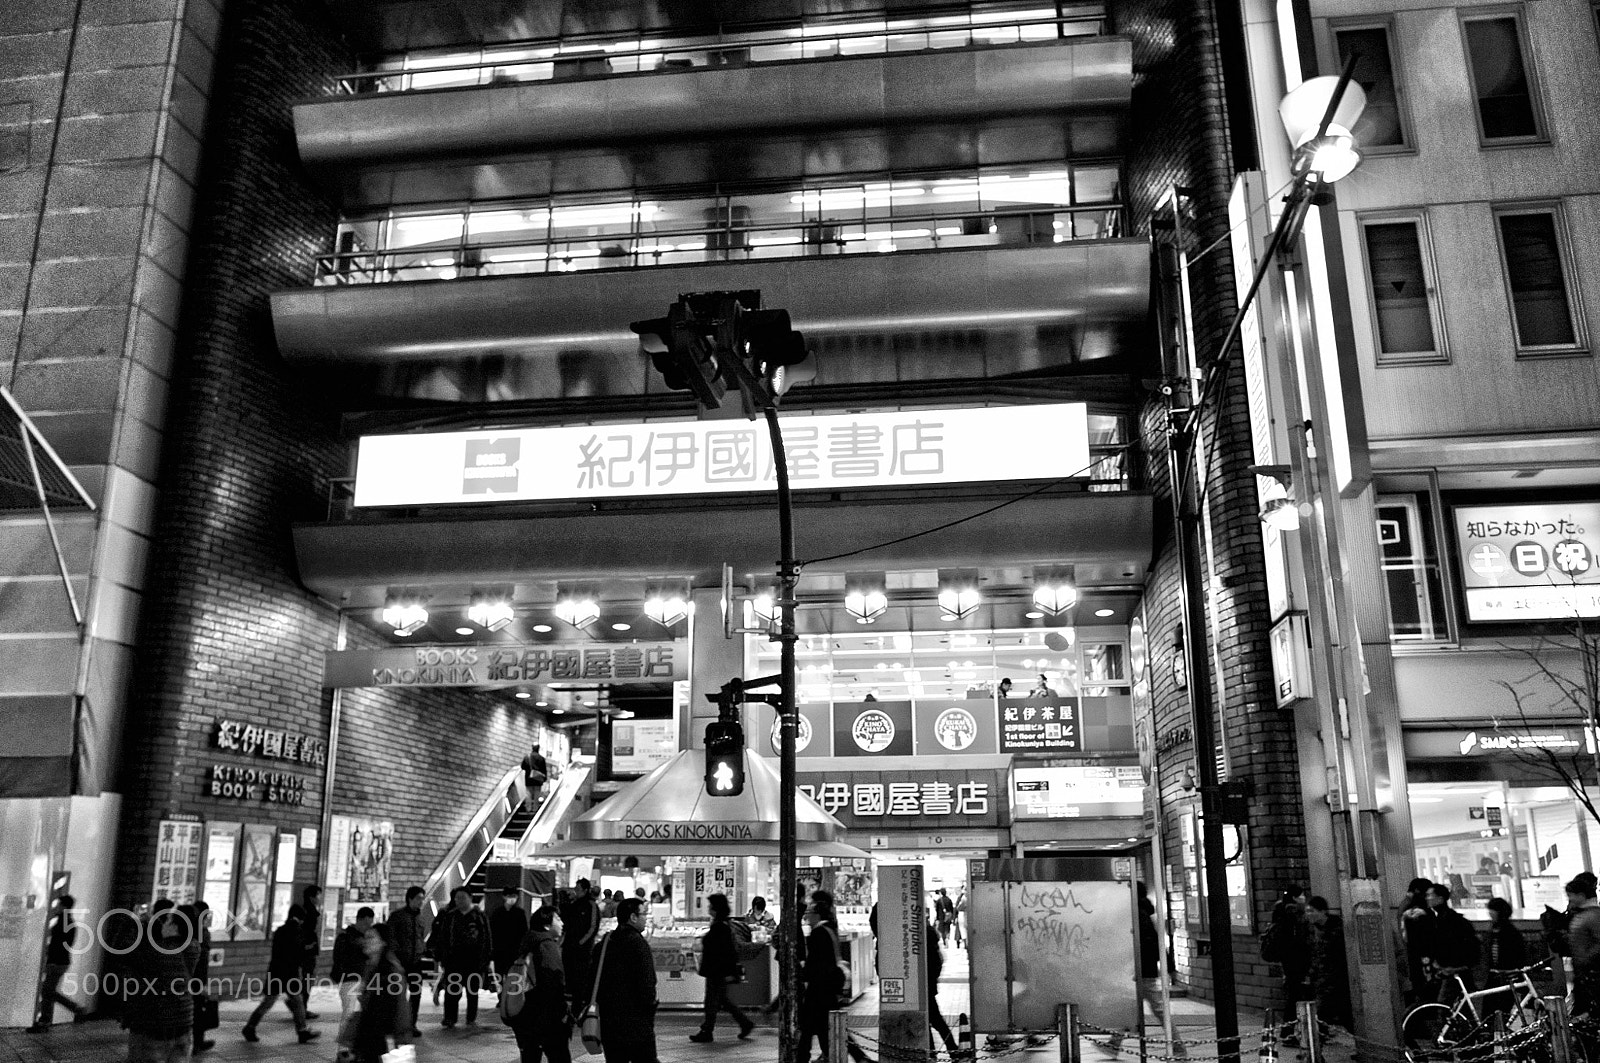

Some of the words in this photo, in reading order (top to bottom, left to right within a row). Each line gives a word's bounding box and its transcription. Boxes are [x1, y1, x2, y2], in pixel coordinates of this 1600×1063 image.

[577, 419, 944, 489] 紀伊國屋書店
[1467, 519, 1585, 538] 知らなかった。
[416, 647, 478, 666] BOOKS
[487, 645, 673, 682] 紀伊國屋書店
[372, 667, 479, 685] KINOKUNIYA
[1005, 740, 1044, 748] Kinokuniya
[1019, 732, 1036, 740] floor
[212, 781, 256, 799] BOOK
[626, 824, 670, 838] BOOKS
[674, 824, 753, 838] KINOKUNIYA
[910, 868, 920, 901] Clean
[909, 904, 921, 955] Shinjuku
